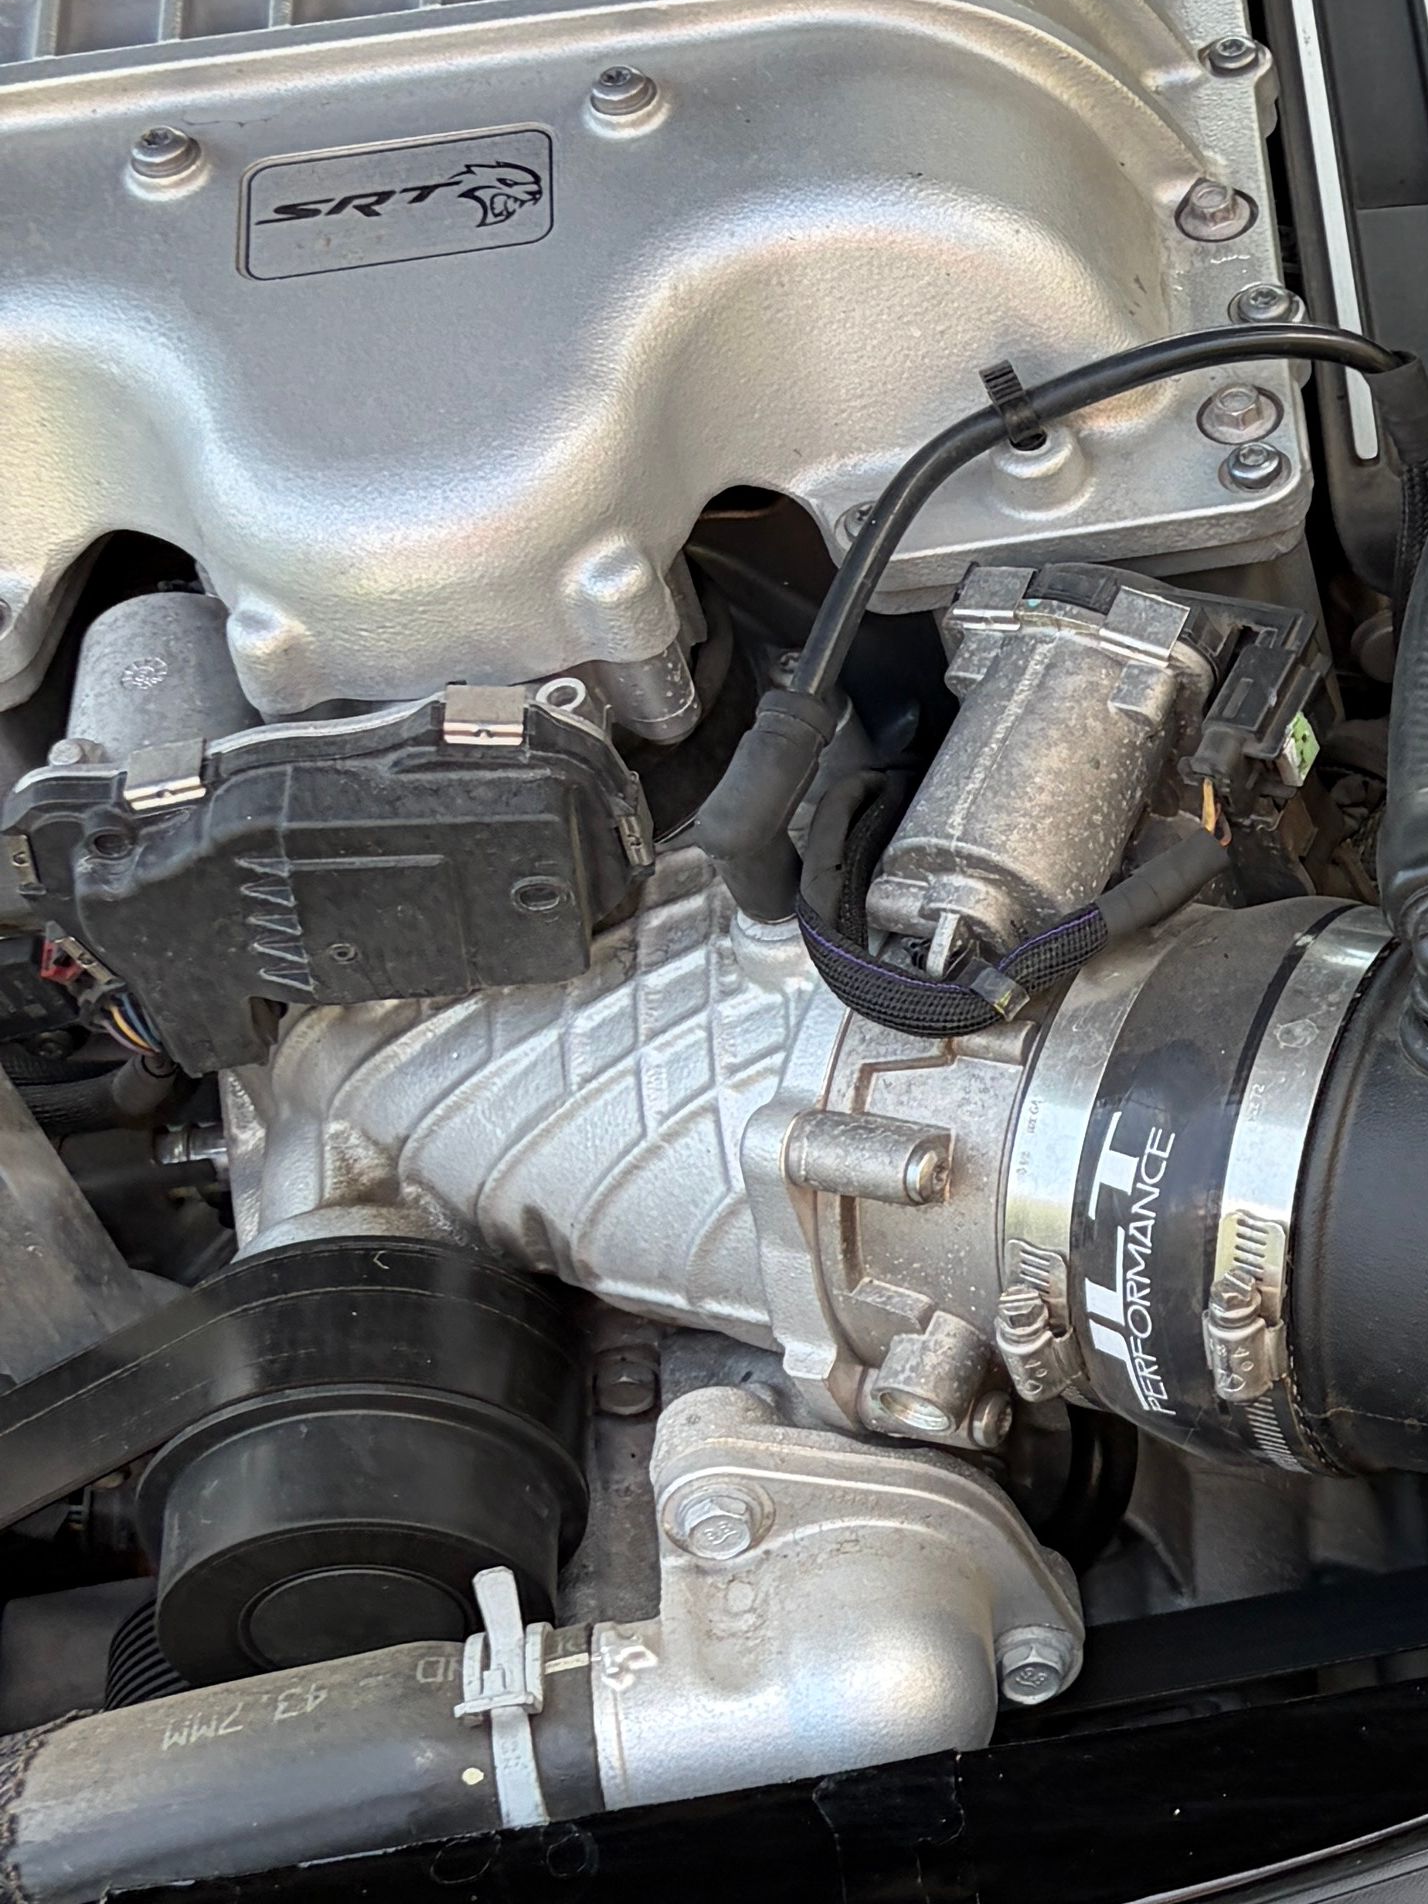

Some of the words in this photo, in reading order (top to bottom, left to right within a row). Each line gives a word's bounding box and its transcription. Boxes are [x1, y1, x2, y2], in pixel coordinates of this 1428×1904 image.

[254, 178, 466, 226] SRT
[1084, 1110, 1151, 1414] JLT
[1122, 1125, 1177, 1415] PERFORMANCE
